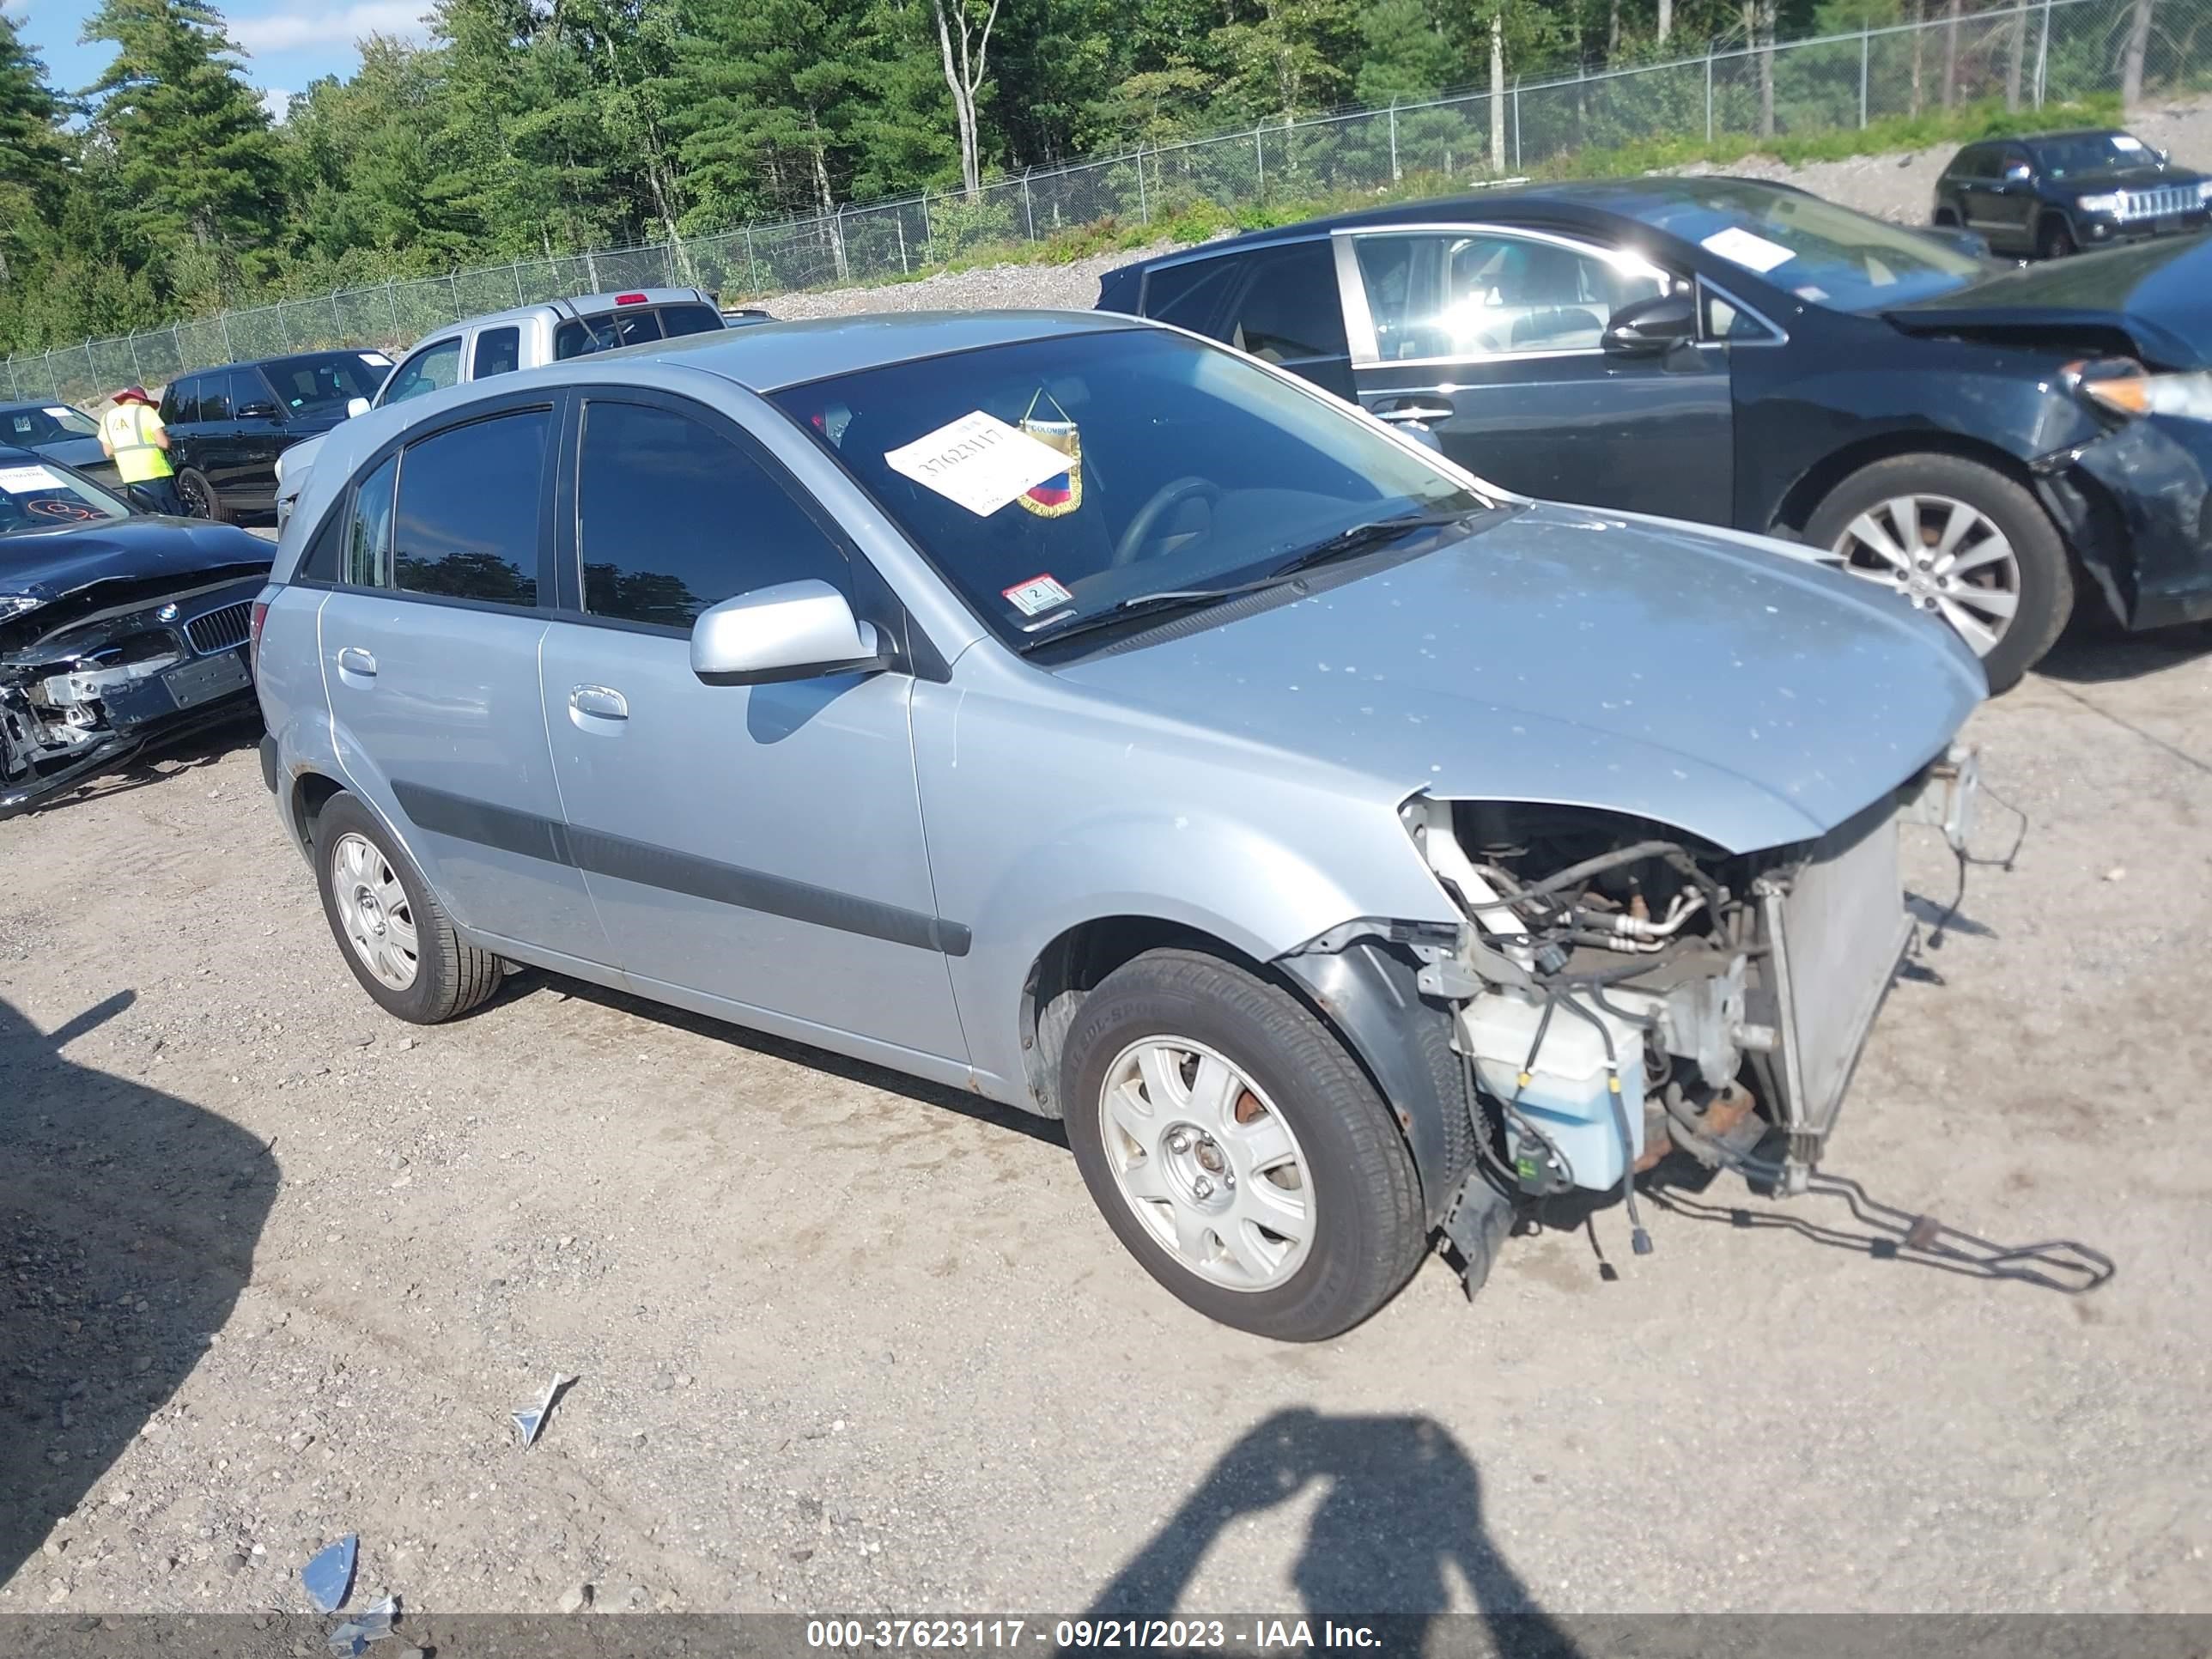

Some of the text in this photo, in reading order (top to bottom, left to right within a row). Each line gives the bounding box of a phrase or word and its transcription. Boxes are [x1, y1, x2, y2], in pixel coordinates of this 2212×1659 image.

[1030, 425, 1067, 436] COLOMBIA
[918, 428, 1005, 477] 37623117
[1030, 589, 1042, 599] 2
